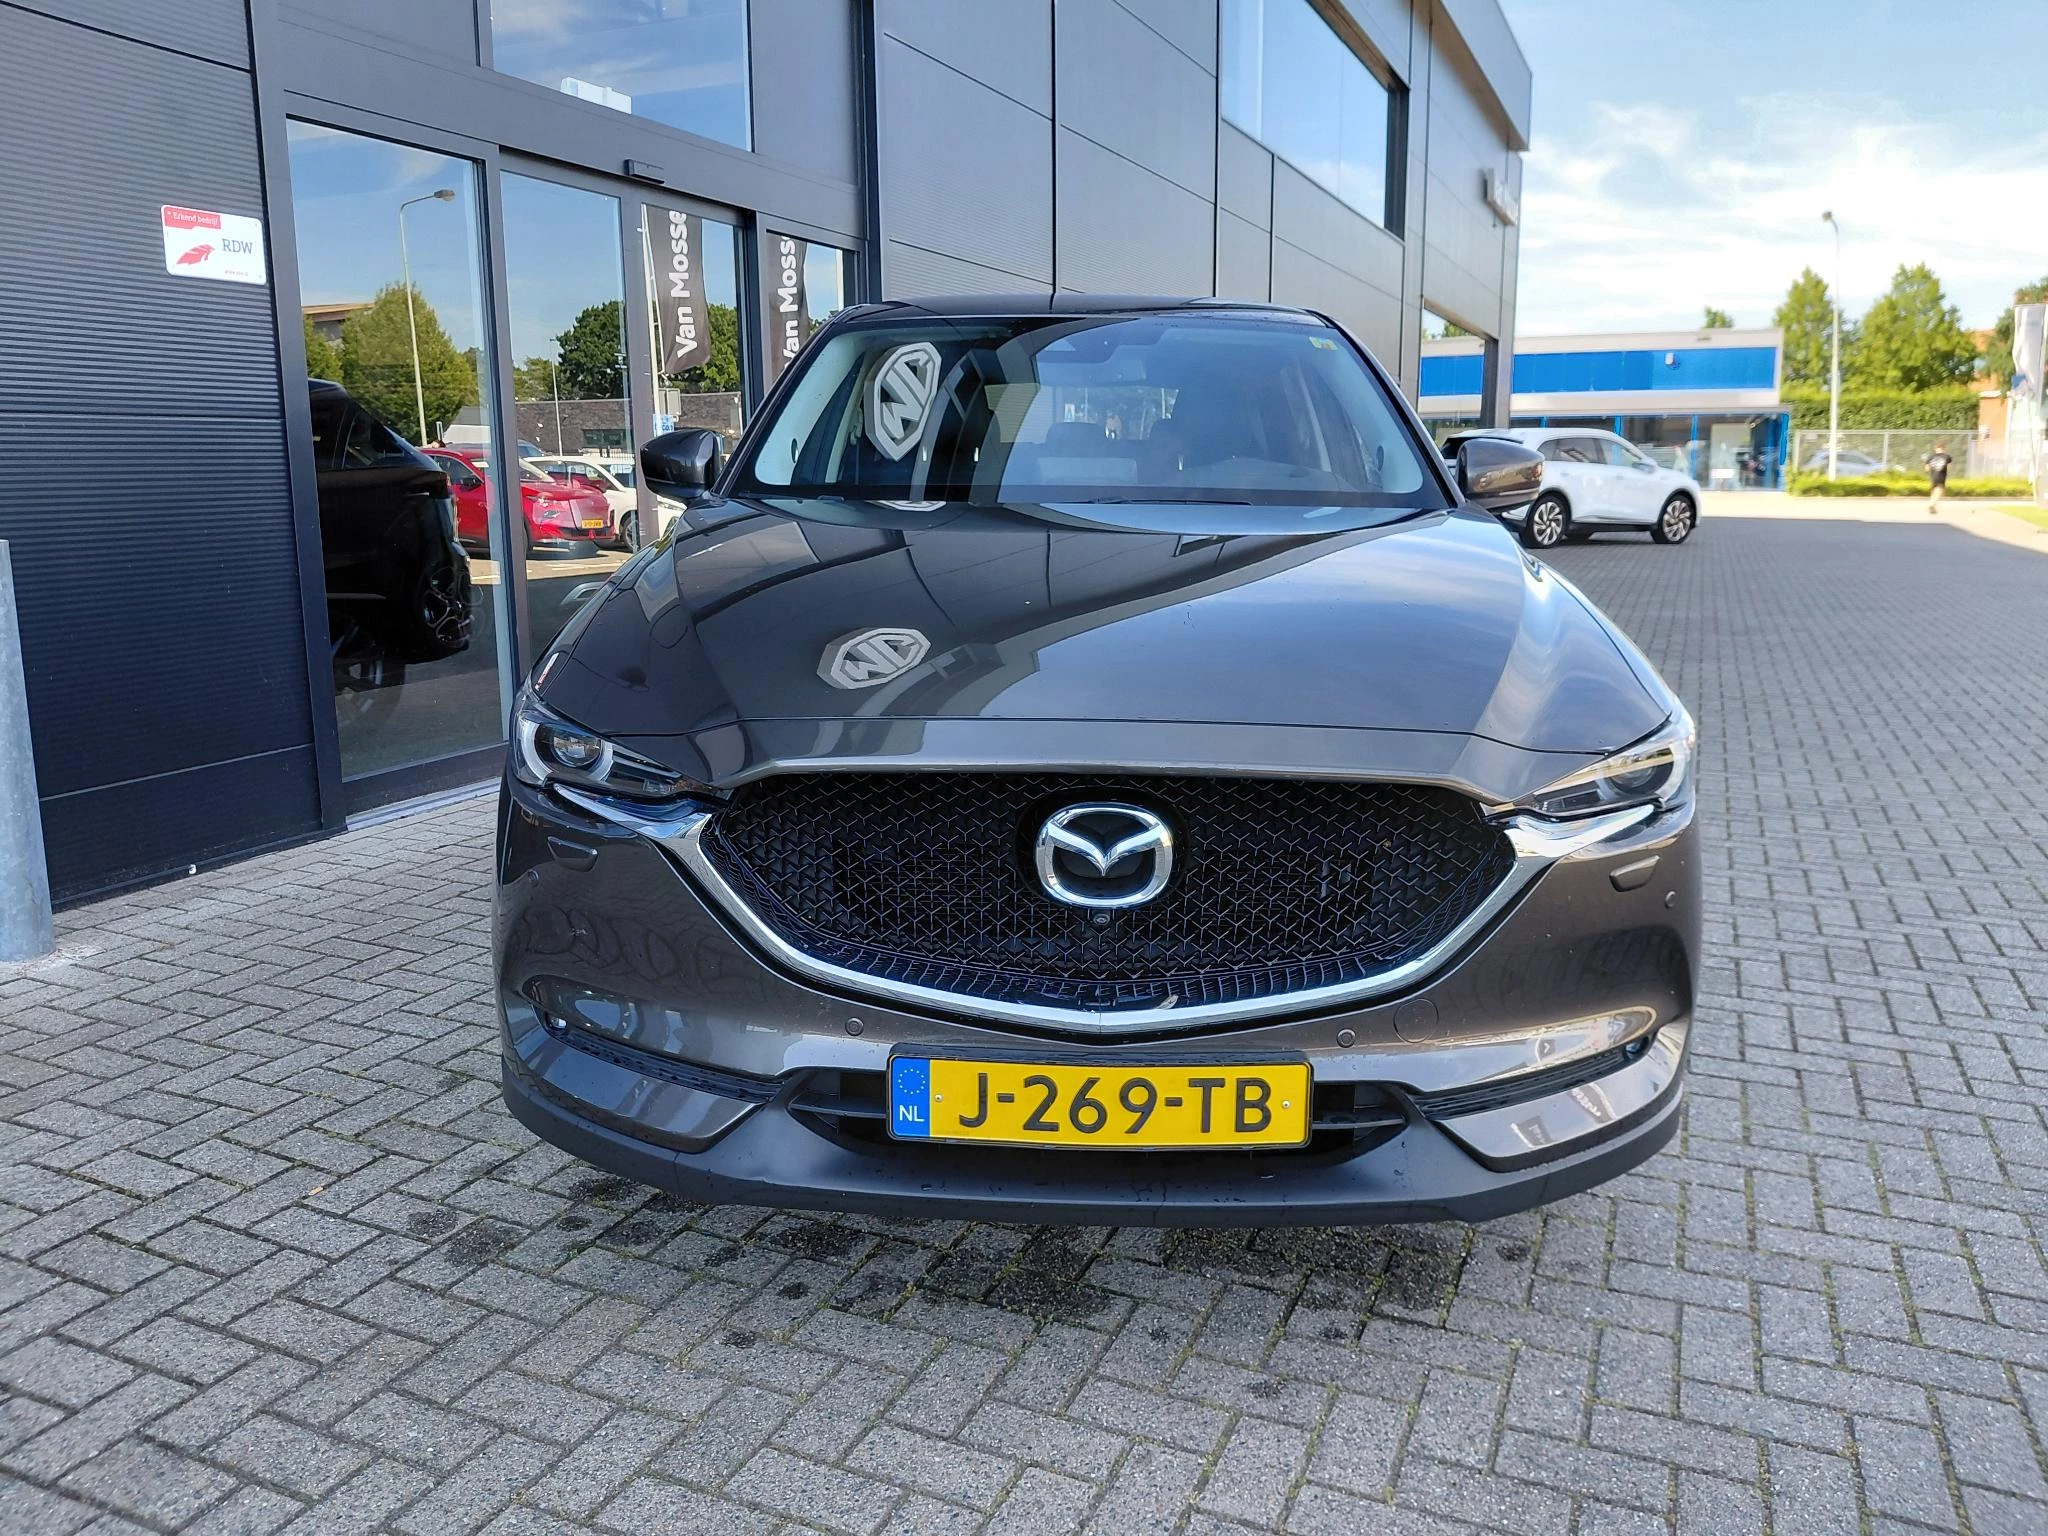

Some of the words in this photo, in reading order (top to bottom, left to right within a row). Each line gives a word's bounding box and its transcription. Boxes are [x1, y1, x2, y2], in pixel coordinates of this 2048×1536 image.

[173, 211, 197, 222] Erkend
[221, 238, 253, 254] RDW
[777, 235, 798, 313] Moss
[675, 306, 698, 359] Van
[899, 1104, 925, 1123] NL
[958, 1072, 1272, 1134] J-269-TB
